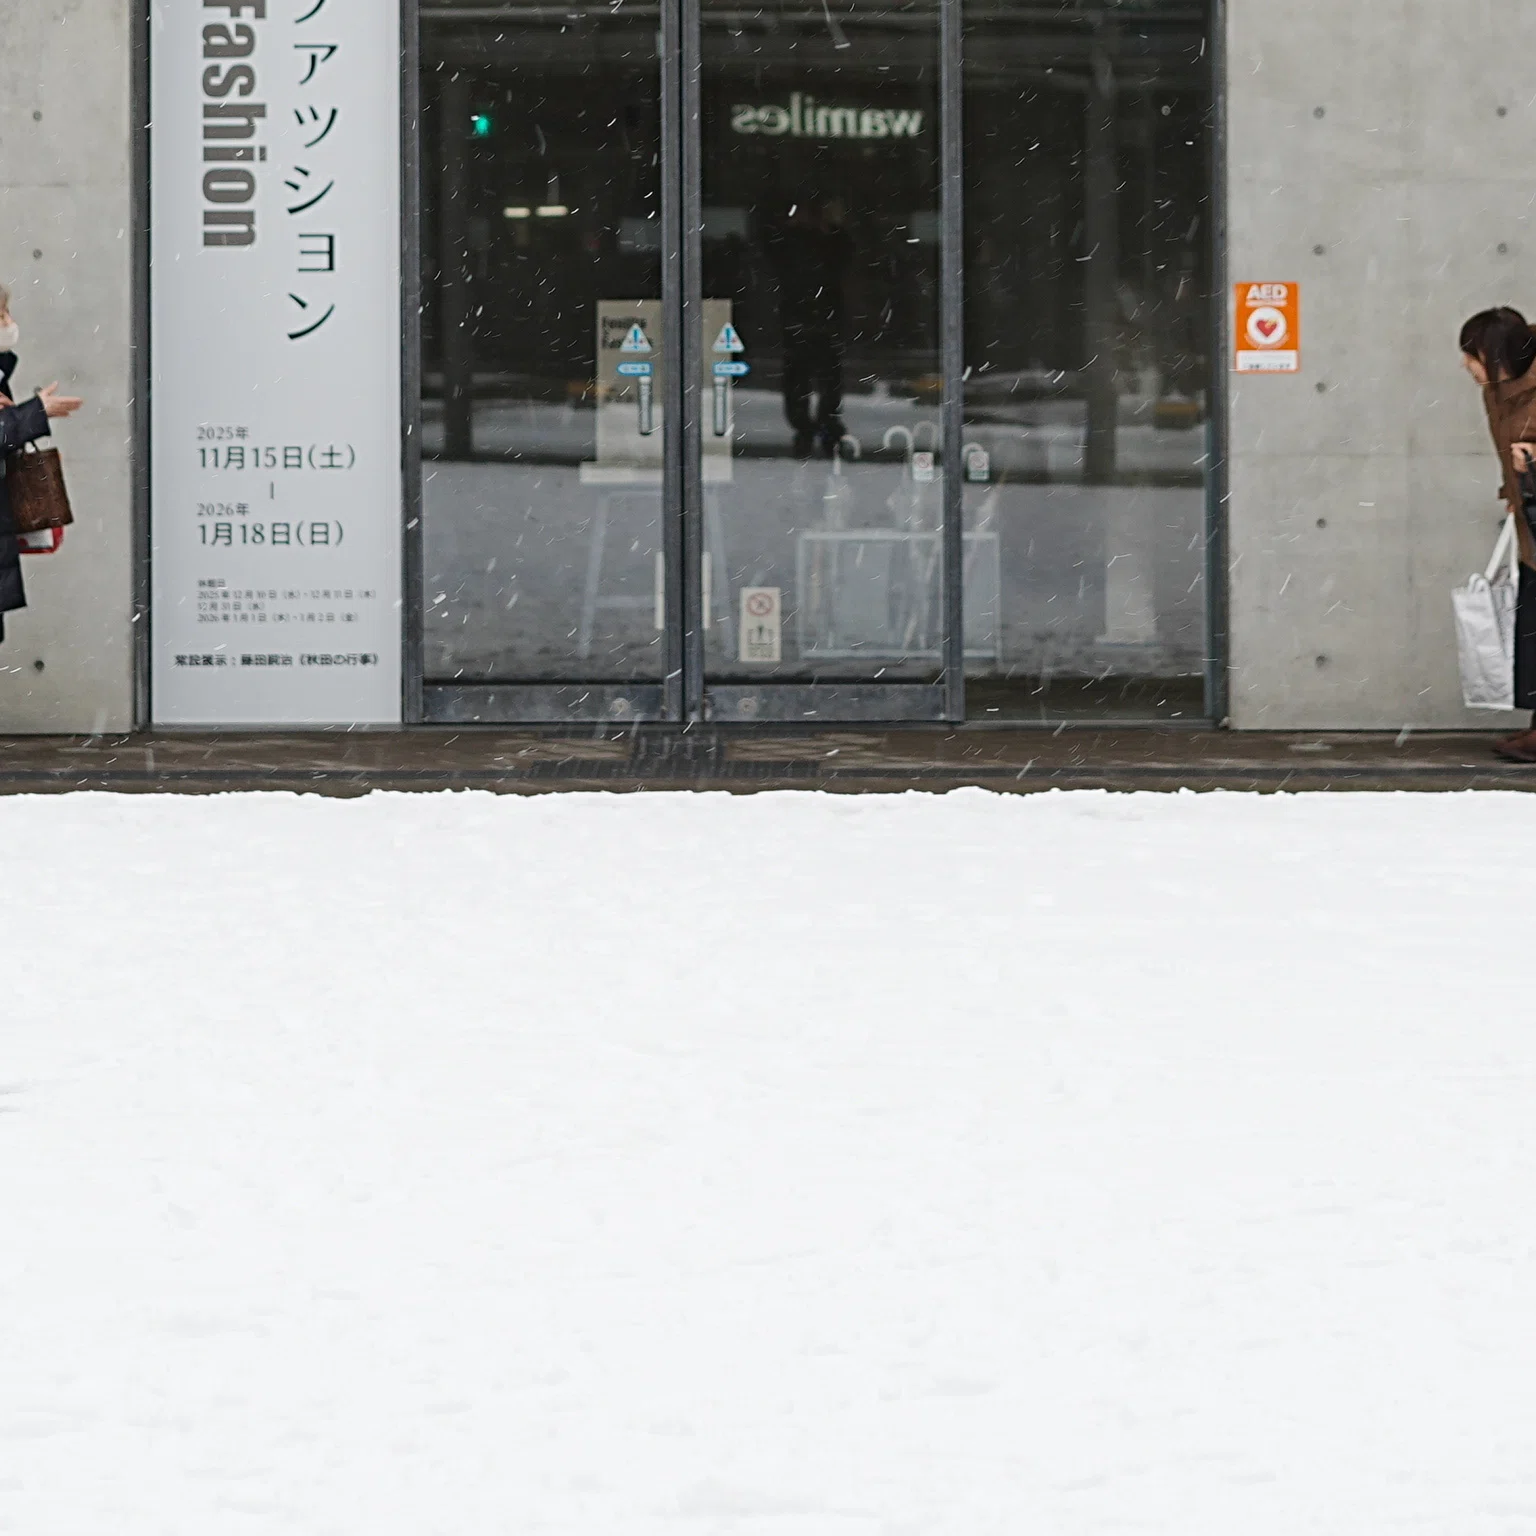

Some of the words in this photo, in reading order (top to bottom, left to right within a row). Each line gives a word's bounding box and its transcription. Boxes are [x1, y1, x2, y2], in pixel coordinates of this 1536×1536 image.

[1247, 284, 1288, 300] AED
[198, 427, 249, 440] 2025年
[198, 503, 249, 516] 2026年
